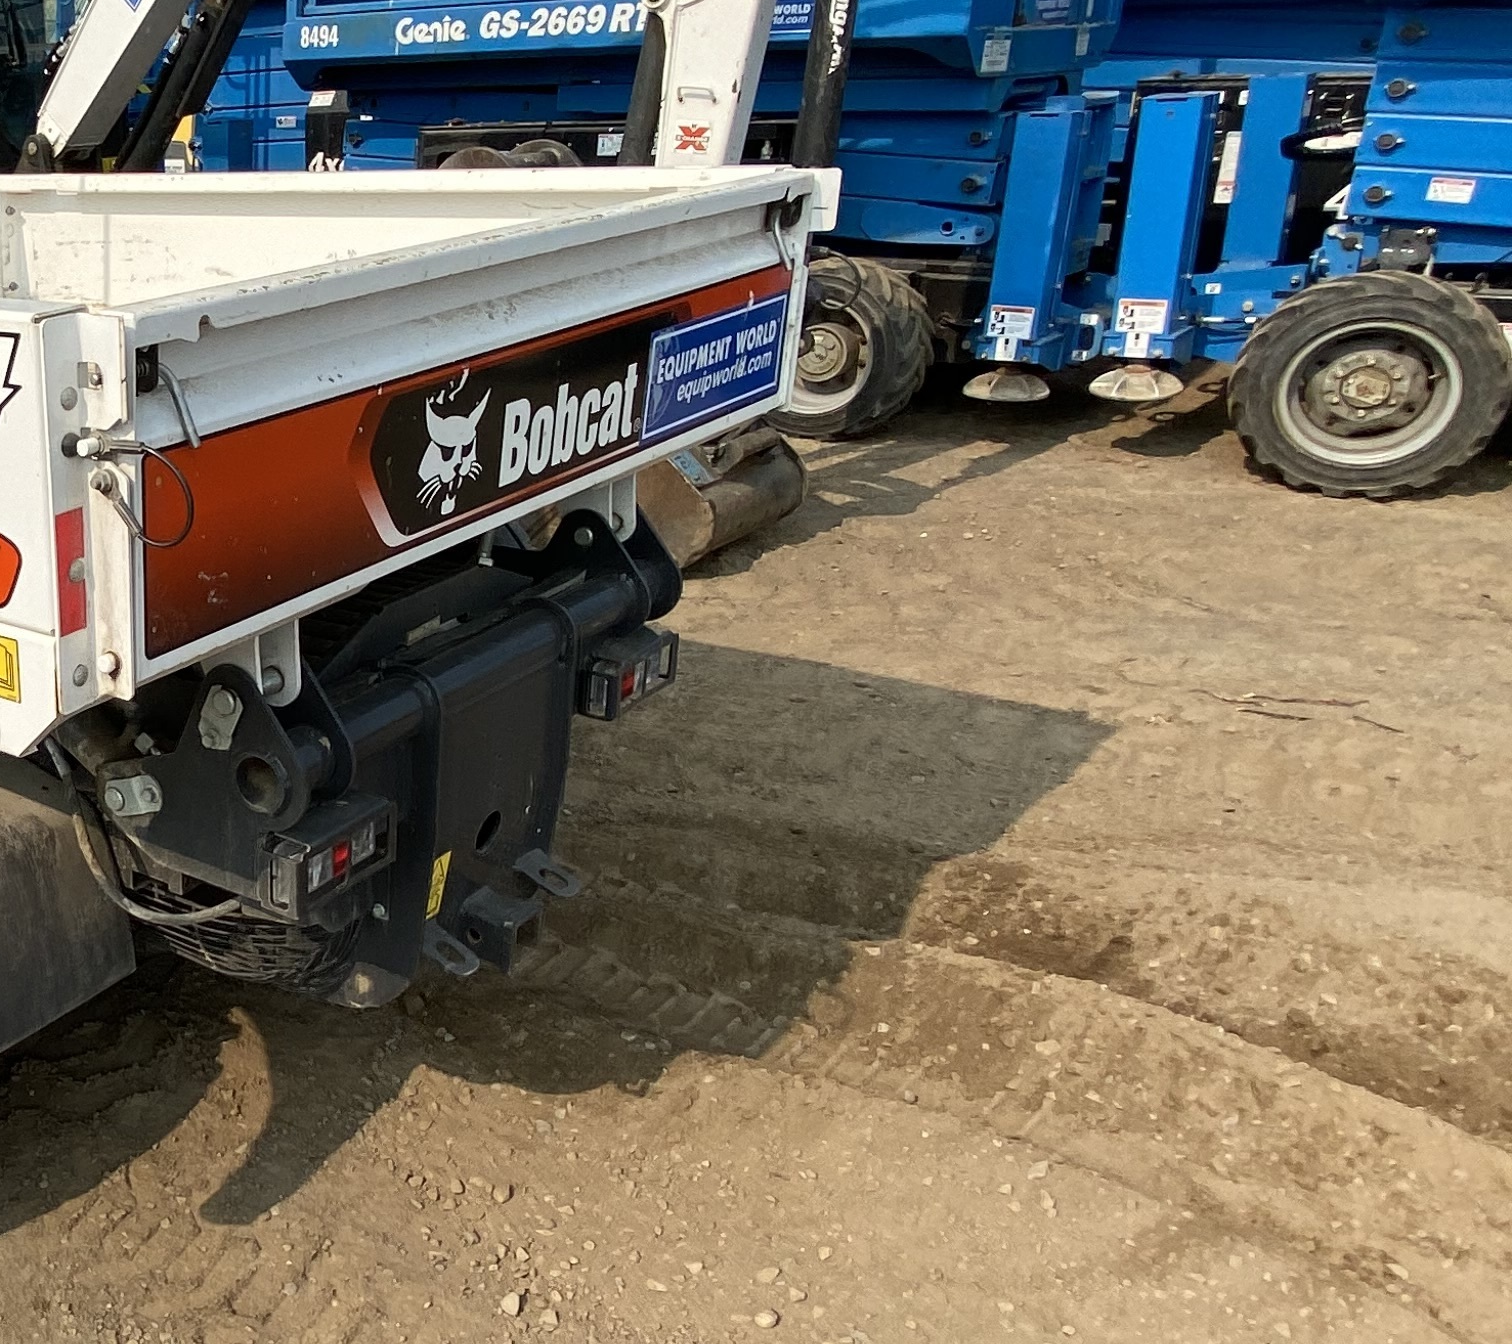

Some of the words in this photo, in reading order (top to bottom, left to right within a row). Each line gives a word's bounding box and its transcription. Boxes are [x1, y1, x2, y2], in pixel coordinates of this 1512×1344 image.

[300, 24, 339, 49] 8494
[394, 15, 467, 46] Genie
[478, 4, 606, 40] GS-2669
[657, 335, 732, 385] EQUIPMENT
[735, 319, 778, 355] WORLD
[676, 351, 773, 404] equipworld.com
[498, 362, 638, 488] Bobcat
